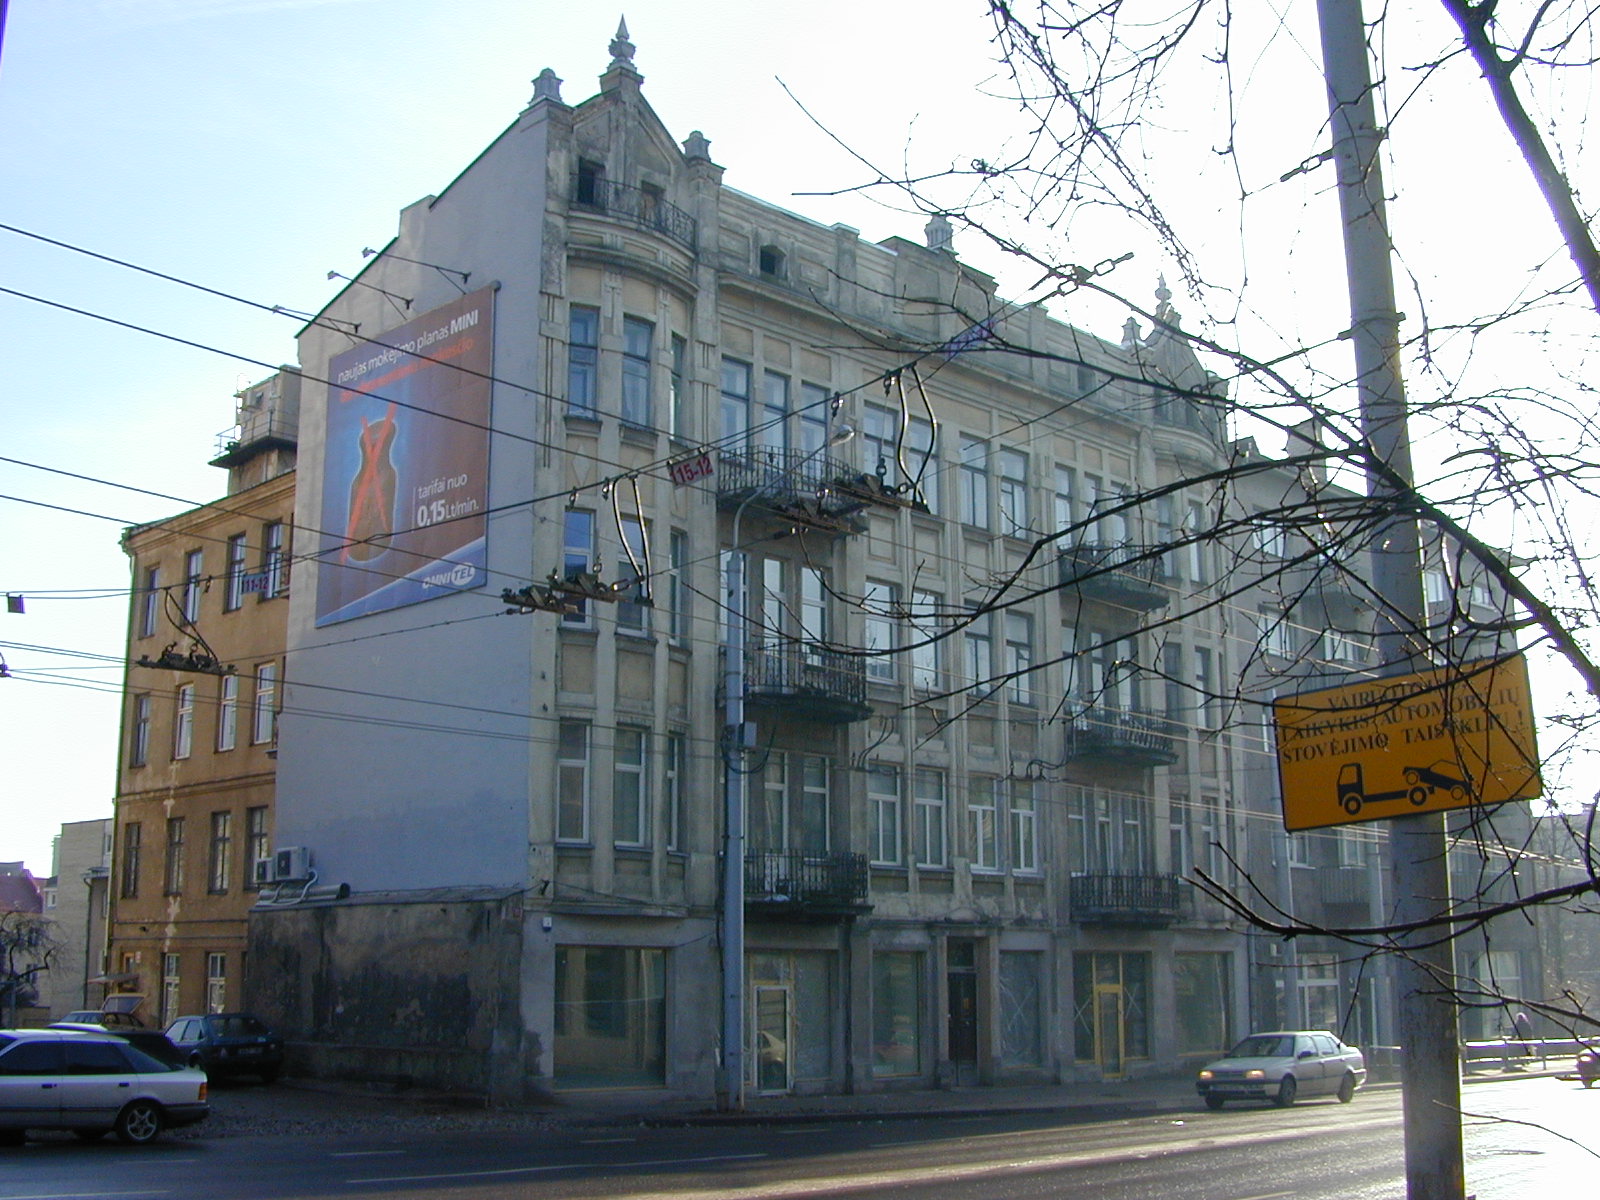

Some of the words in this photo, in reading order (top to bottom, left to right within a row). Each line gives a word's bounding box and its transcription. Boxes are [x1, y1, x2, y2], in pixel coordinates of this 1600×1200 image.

[338, 361, 367, 384] naujas
[417, 326, 449, 352] planas
[450, 309, 479, 335] MINI
[418, 478, 446, 500] tarifai
[447, 474, 468, 490] nuo
[417, 499, 446, 527] 0,15
[422, 565, 475, 589] OMNITEL
[1283, 732, 1390, 763] STOVĖJIMO
